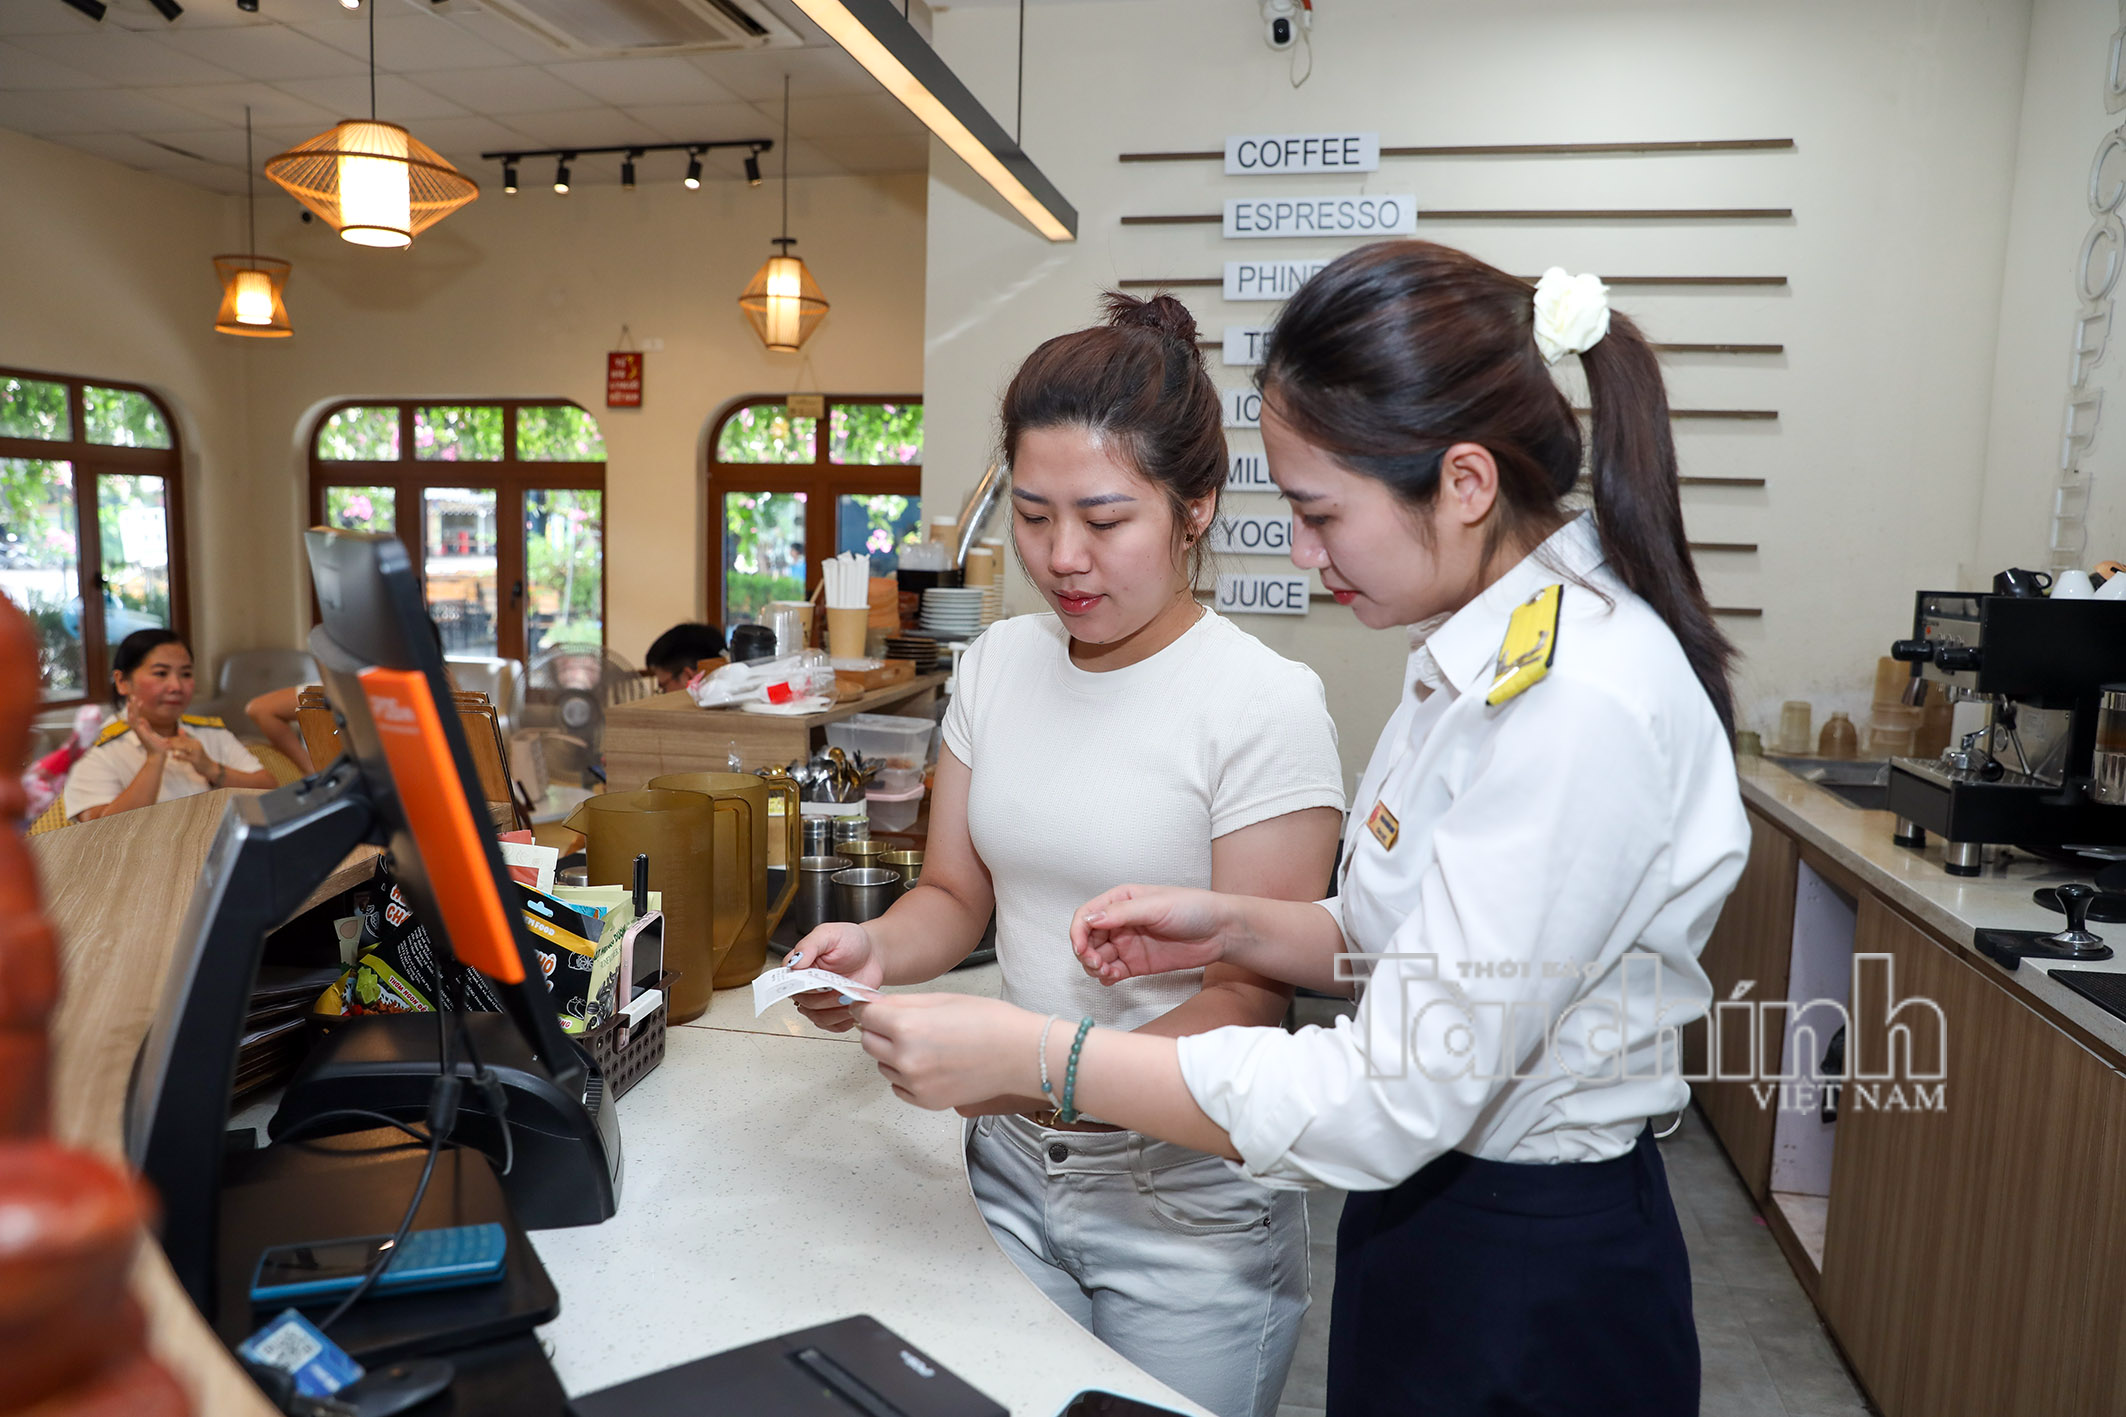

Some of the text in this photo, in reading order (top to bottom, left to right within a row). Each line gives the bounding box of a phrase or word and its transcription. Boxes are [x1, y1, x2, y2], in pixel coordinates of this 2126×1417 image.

[1238, 137, 1360, 168] COFFEE
[1235, 200, 1400, 231] ESPRESSO
[1228, 457, 1274, 484] MIL
[1221, 580, 1303, 609] JUICE
[534, 920, 556, 936] FOOD
